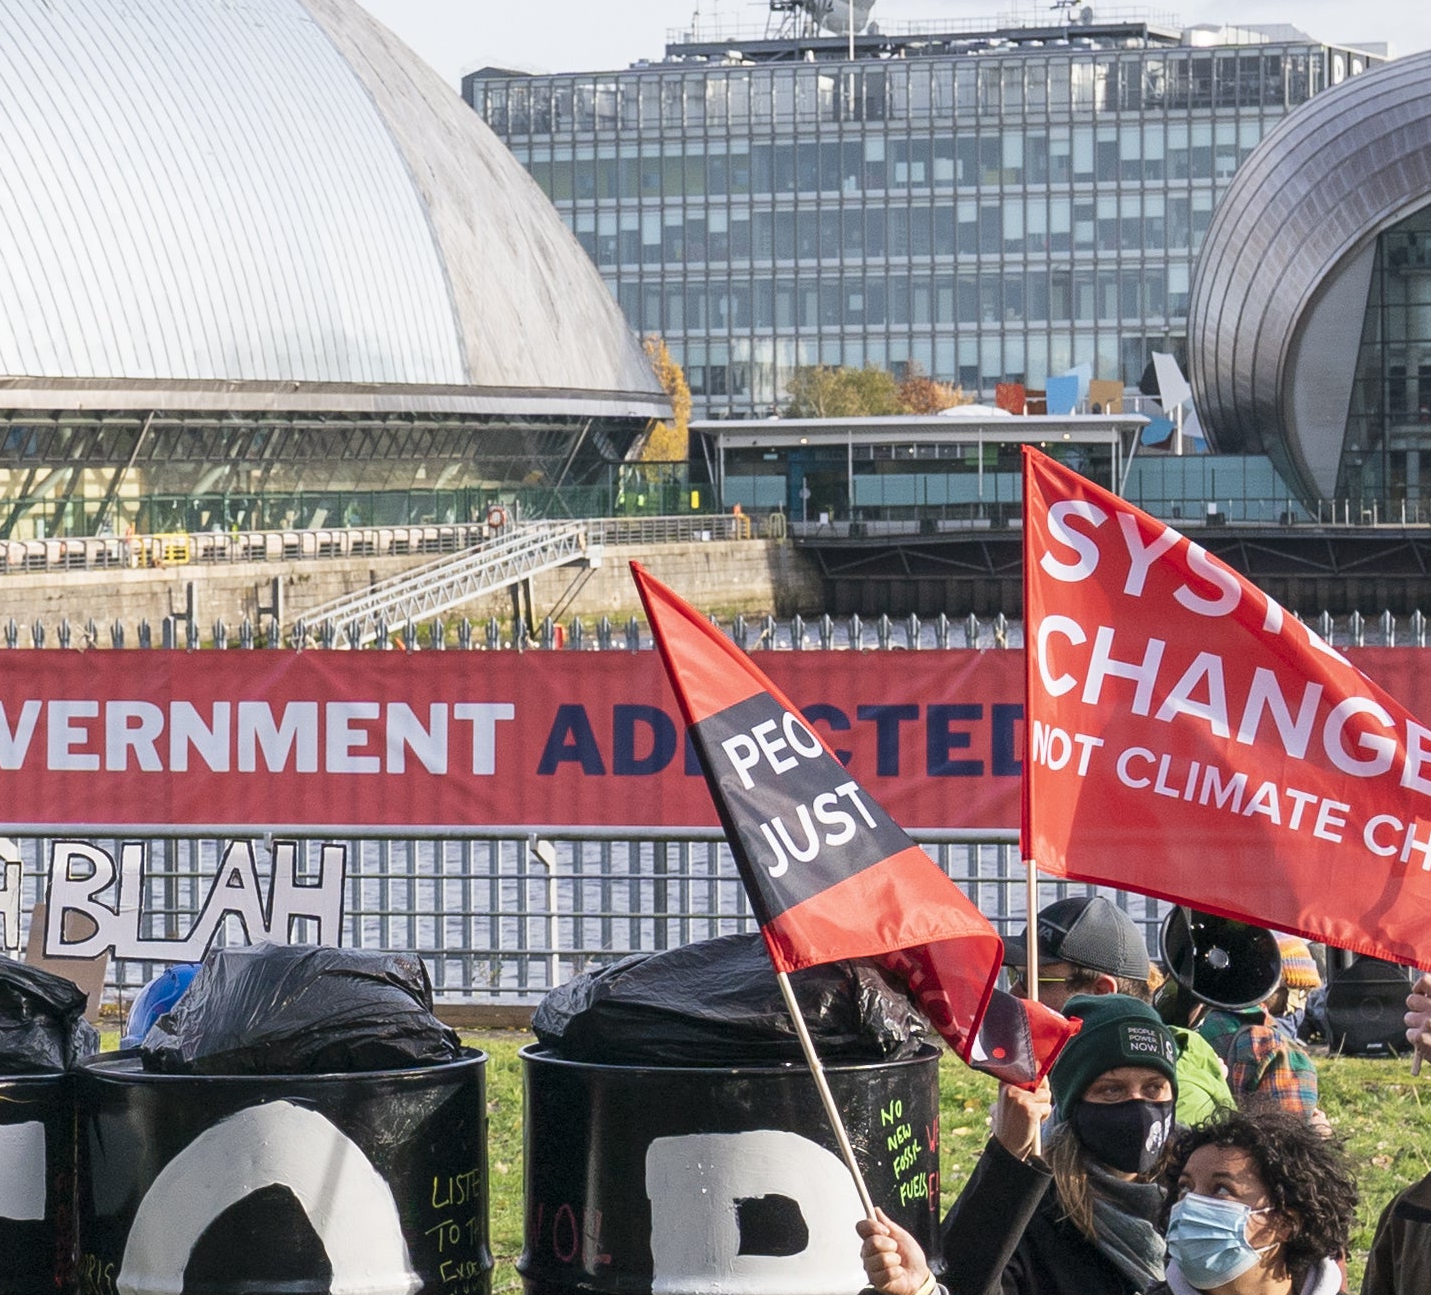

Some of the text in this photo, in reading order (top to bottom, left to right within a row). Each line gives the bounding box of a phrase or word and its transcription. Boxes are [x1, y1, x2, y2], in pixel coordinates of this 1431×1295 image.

[1033, 718, 1105, 777] NOT
[1116, 746, 1351, 844] CLIMATE
[760, 781, 877, 878] JUST
[42, 839, 347, 963] BLAH
[1130, 1042, 1161, 1055] NOW.
[880, 1099, 903, 1126] NO
[887, 1123, 912, 1151] NEW
[431, 1169, 481, 1209] LISTE
[899, 1172, 929, 1207] FUELS
[425, 1219, 460, 1253] TO
